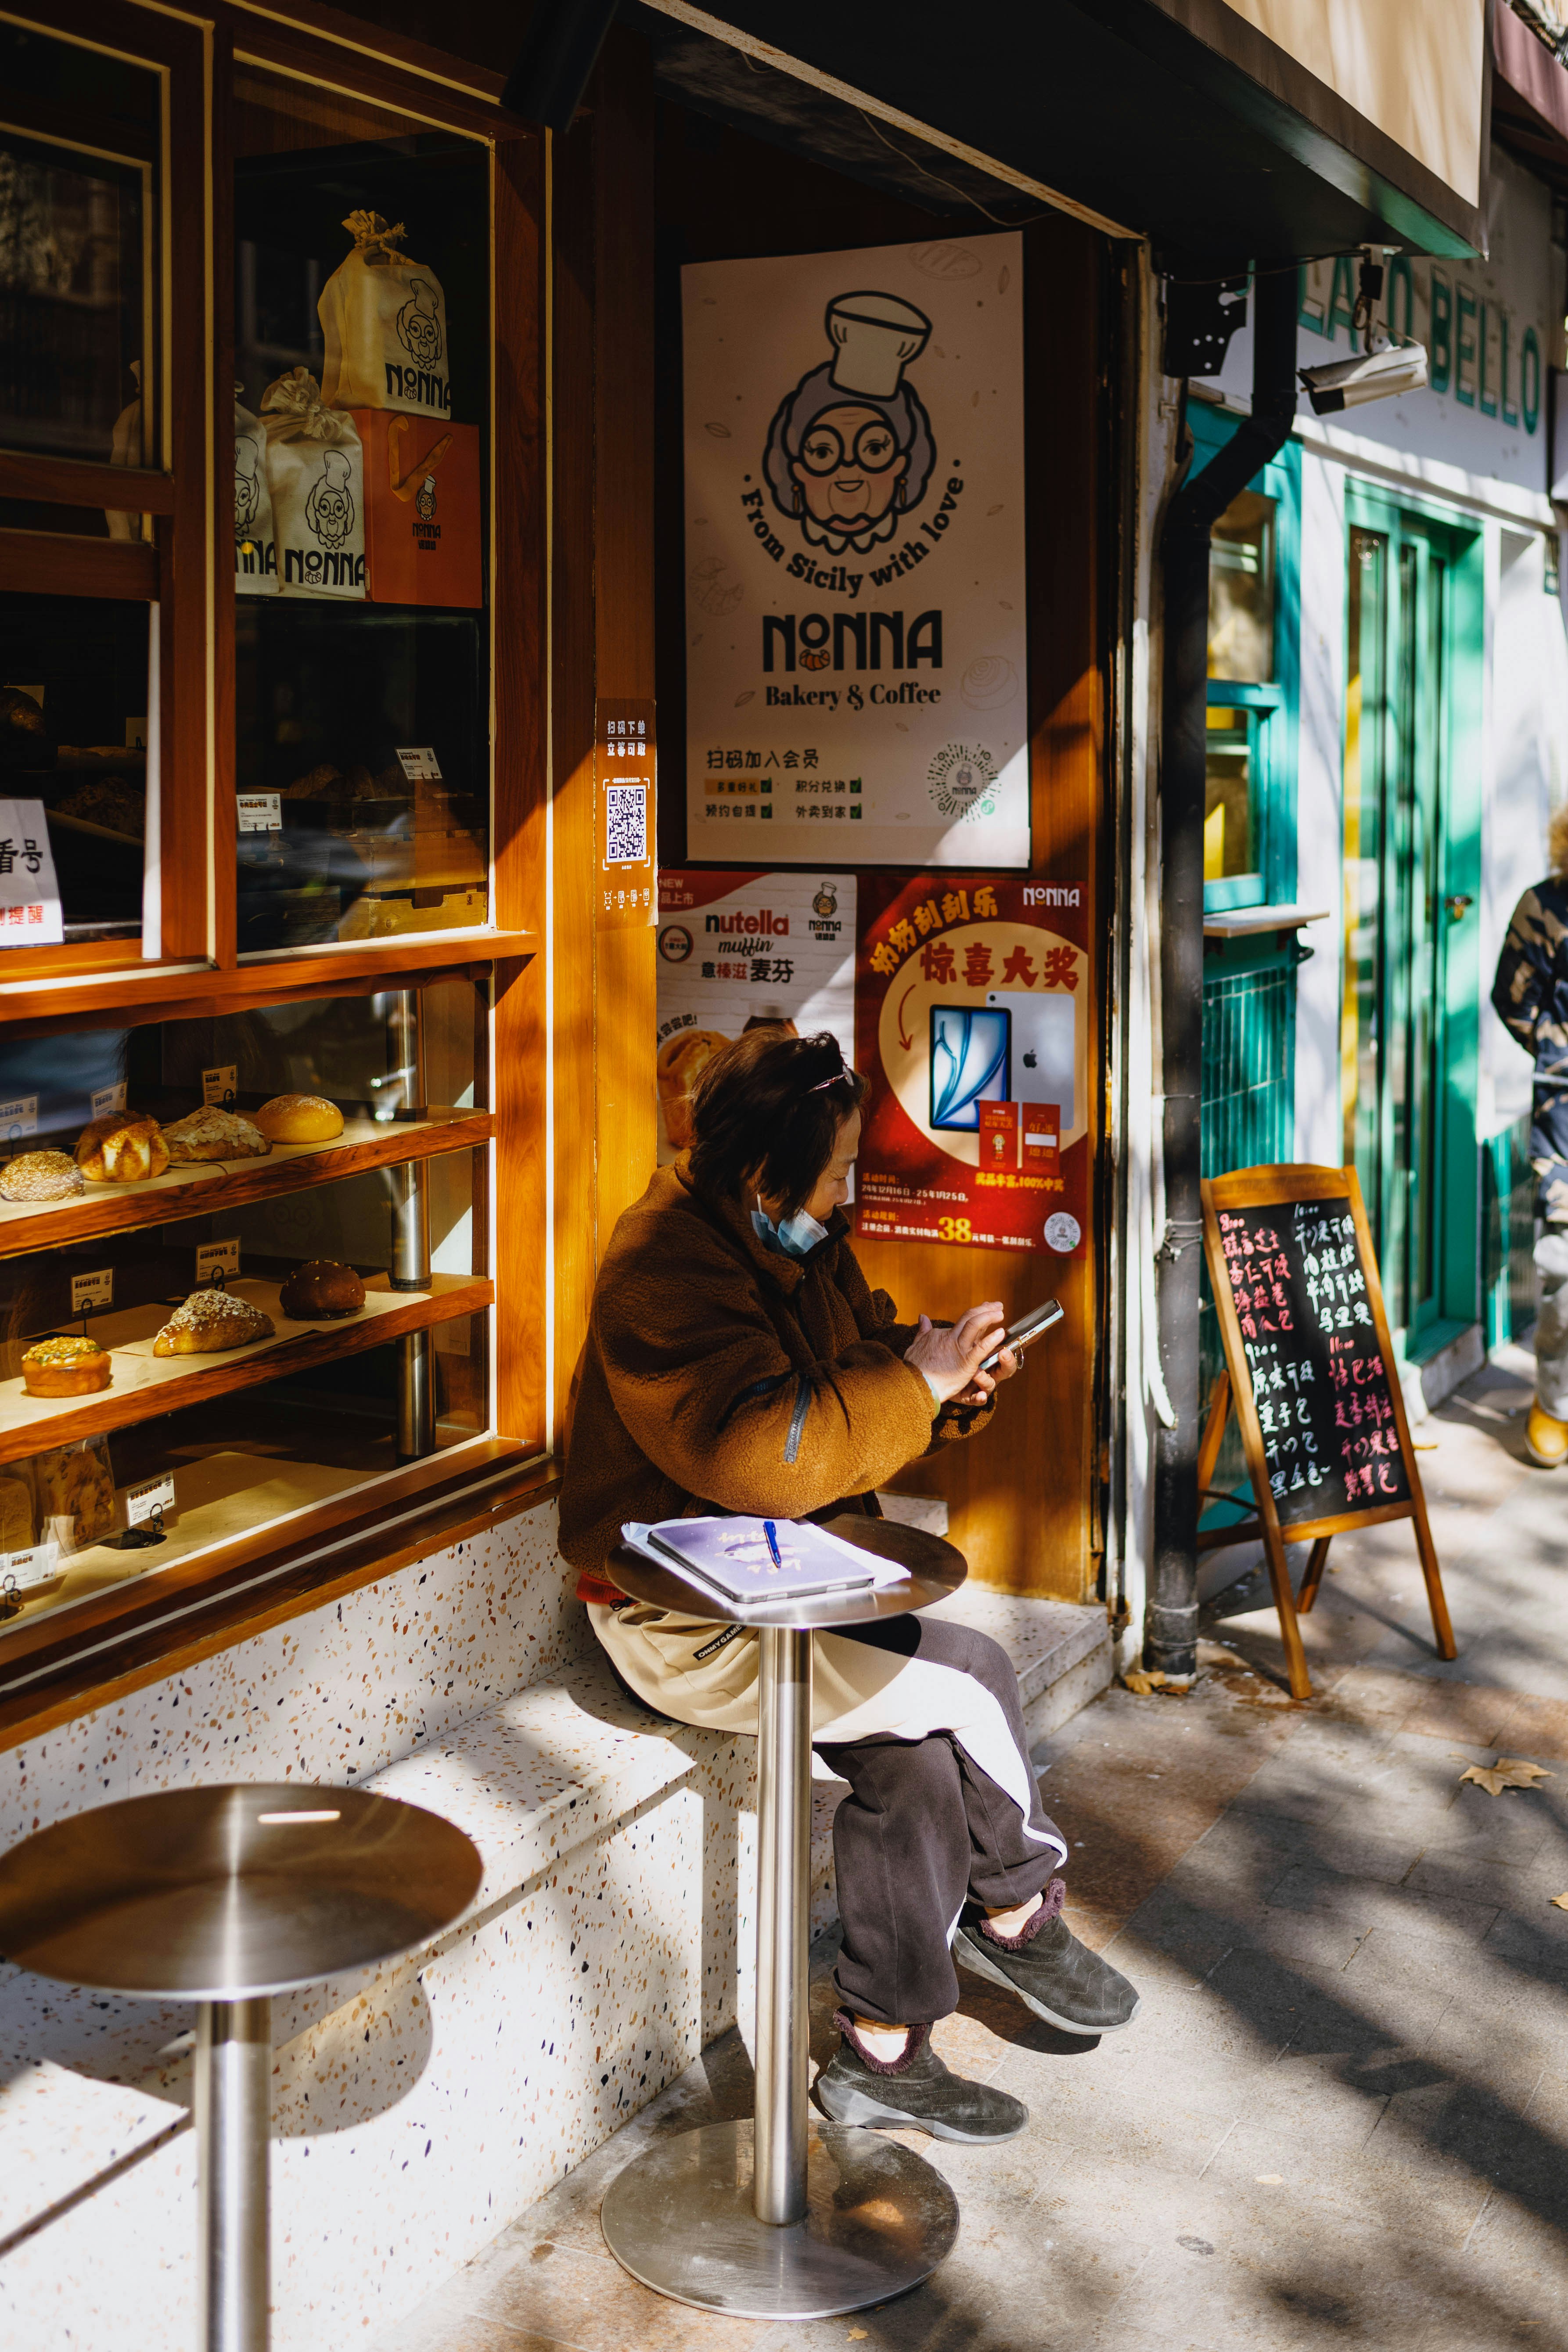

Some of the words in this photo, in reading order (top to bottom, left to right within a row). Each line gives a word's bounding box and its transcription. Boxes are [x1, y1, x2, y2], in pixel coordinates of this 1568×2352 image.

[1431, 264, 1541, 436] BELLO
[385, 363, 452, 410] NONNA
[413, 523, 441, 538] NONNA
[741, 489, 786, 562] From
[786, 553, 863, 599] Sicily
[869, 541, 930, 587] with
[920, 476, 964, 542] love
[285, 549, 365, 586] NONNA
[763, 610, 942, 672] NONNA
[766, 684, 842, 711] Bakery
[847, 684, 864, 710] &
[870, 682, 941, 705] Coffee
[608, 720, 645, 735] 扫码下单
[608, 741, 645, 757] 立等可取
[707, 749, 818, 769] 扫码加入会员
[796, 780, 845, 793] 积分兑换
[706, 805, 756, 818] 预约自提
[796, 806, 845, 818] 外卖到家
[659, 878, 683, 888] NEW
[658, 893, 694, 905] 品上市
[1023, 888, 1080, 907] NONNA
[706, 910, 789, 935] nutella
[809, 920, 841, 931] NONNA
[870, 886, 998, 976] 奶奶刮刮乐
[718, 938, 774, 957] muffin
[920, 942, 1079, 991] 惊喜大奖
